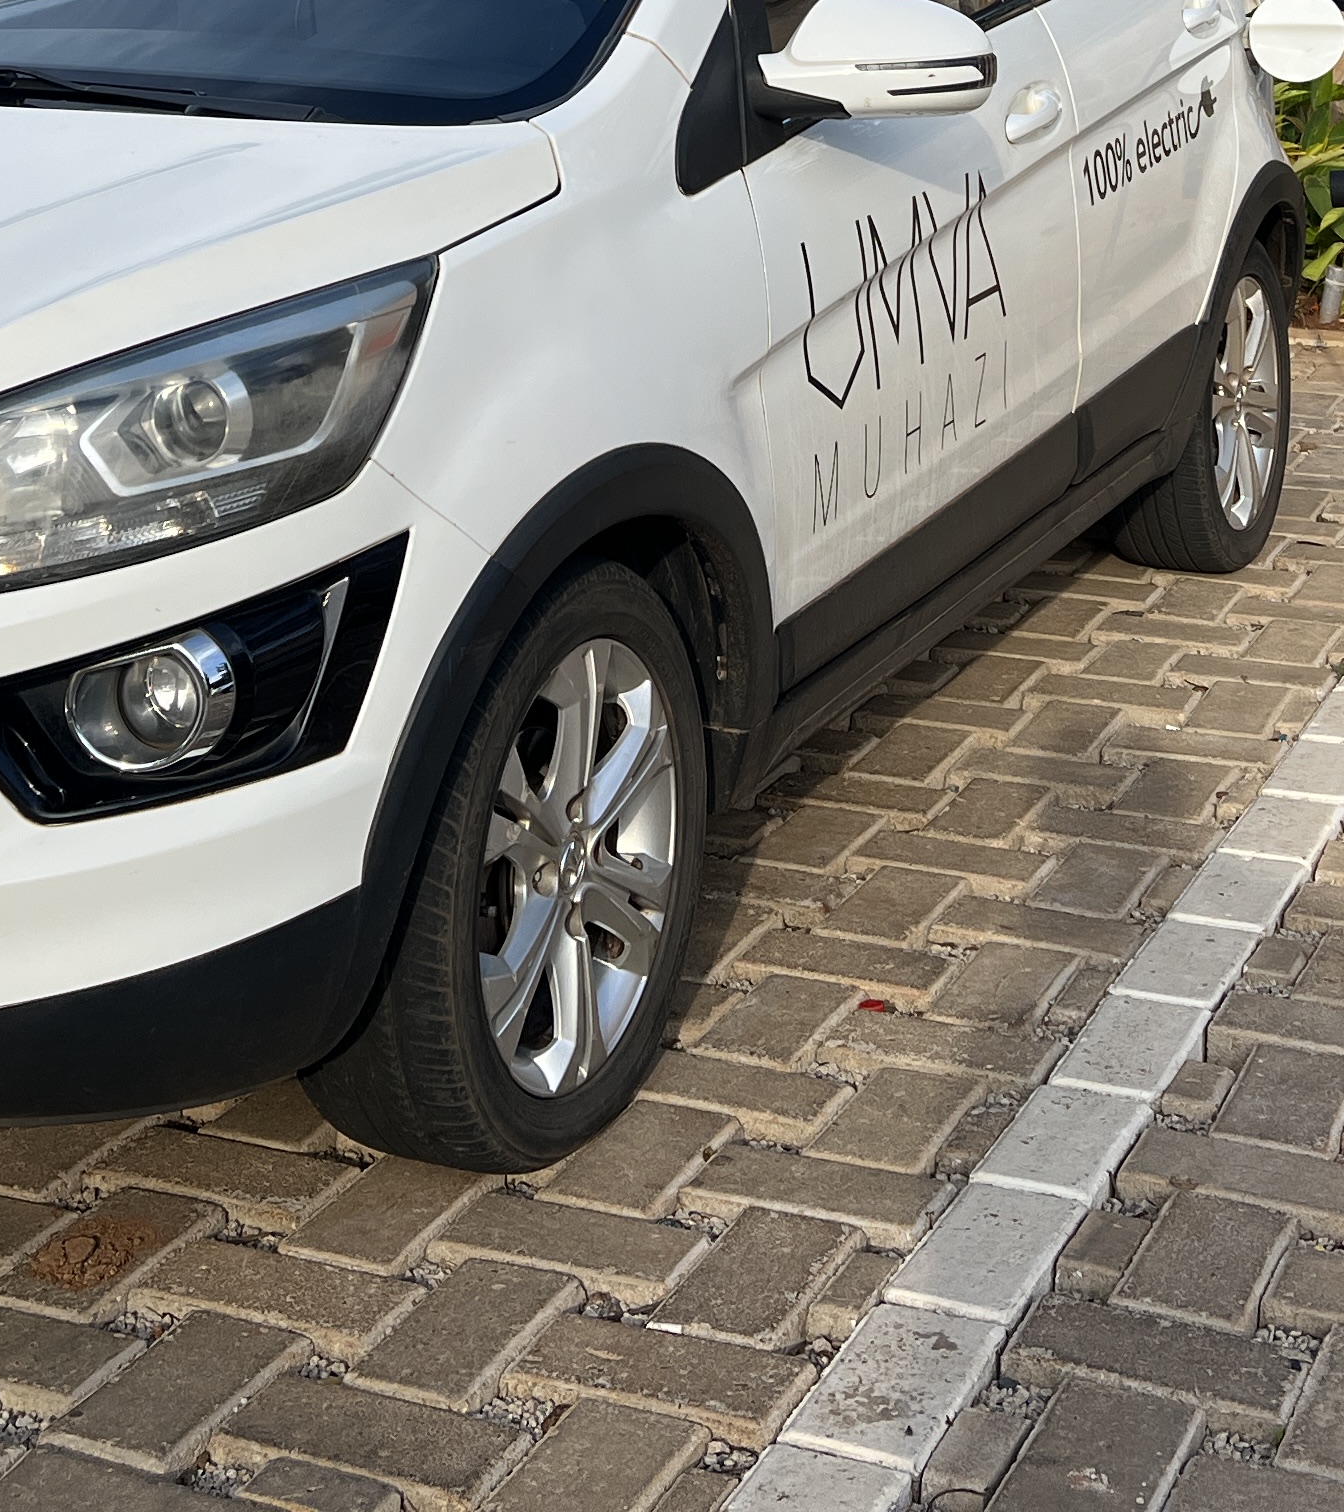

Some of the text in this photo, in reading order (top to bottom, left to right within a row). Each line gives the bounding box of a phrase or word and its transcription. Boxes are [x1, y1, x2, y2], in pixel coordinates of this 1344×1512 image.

[1083, 98, 1200, 206] 100% electric
[800, 169, 1006, 410] UMVA
[813, 340, 1008, 535] MUHAZI
